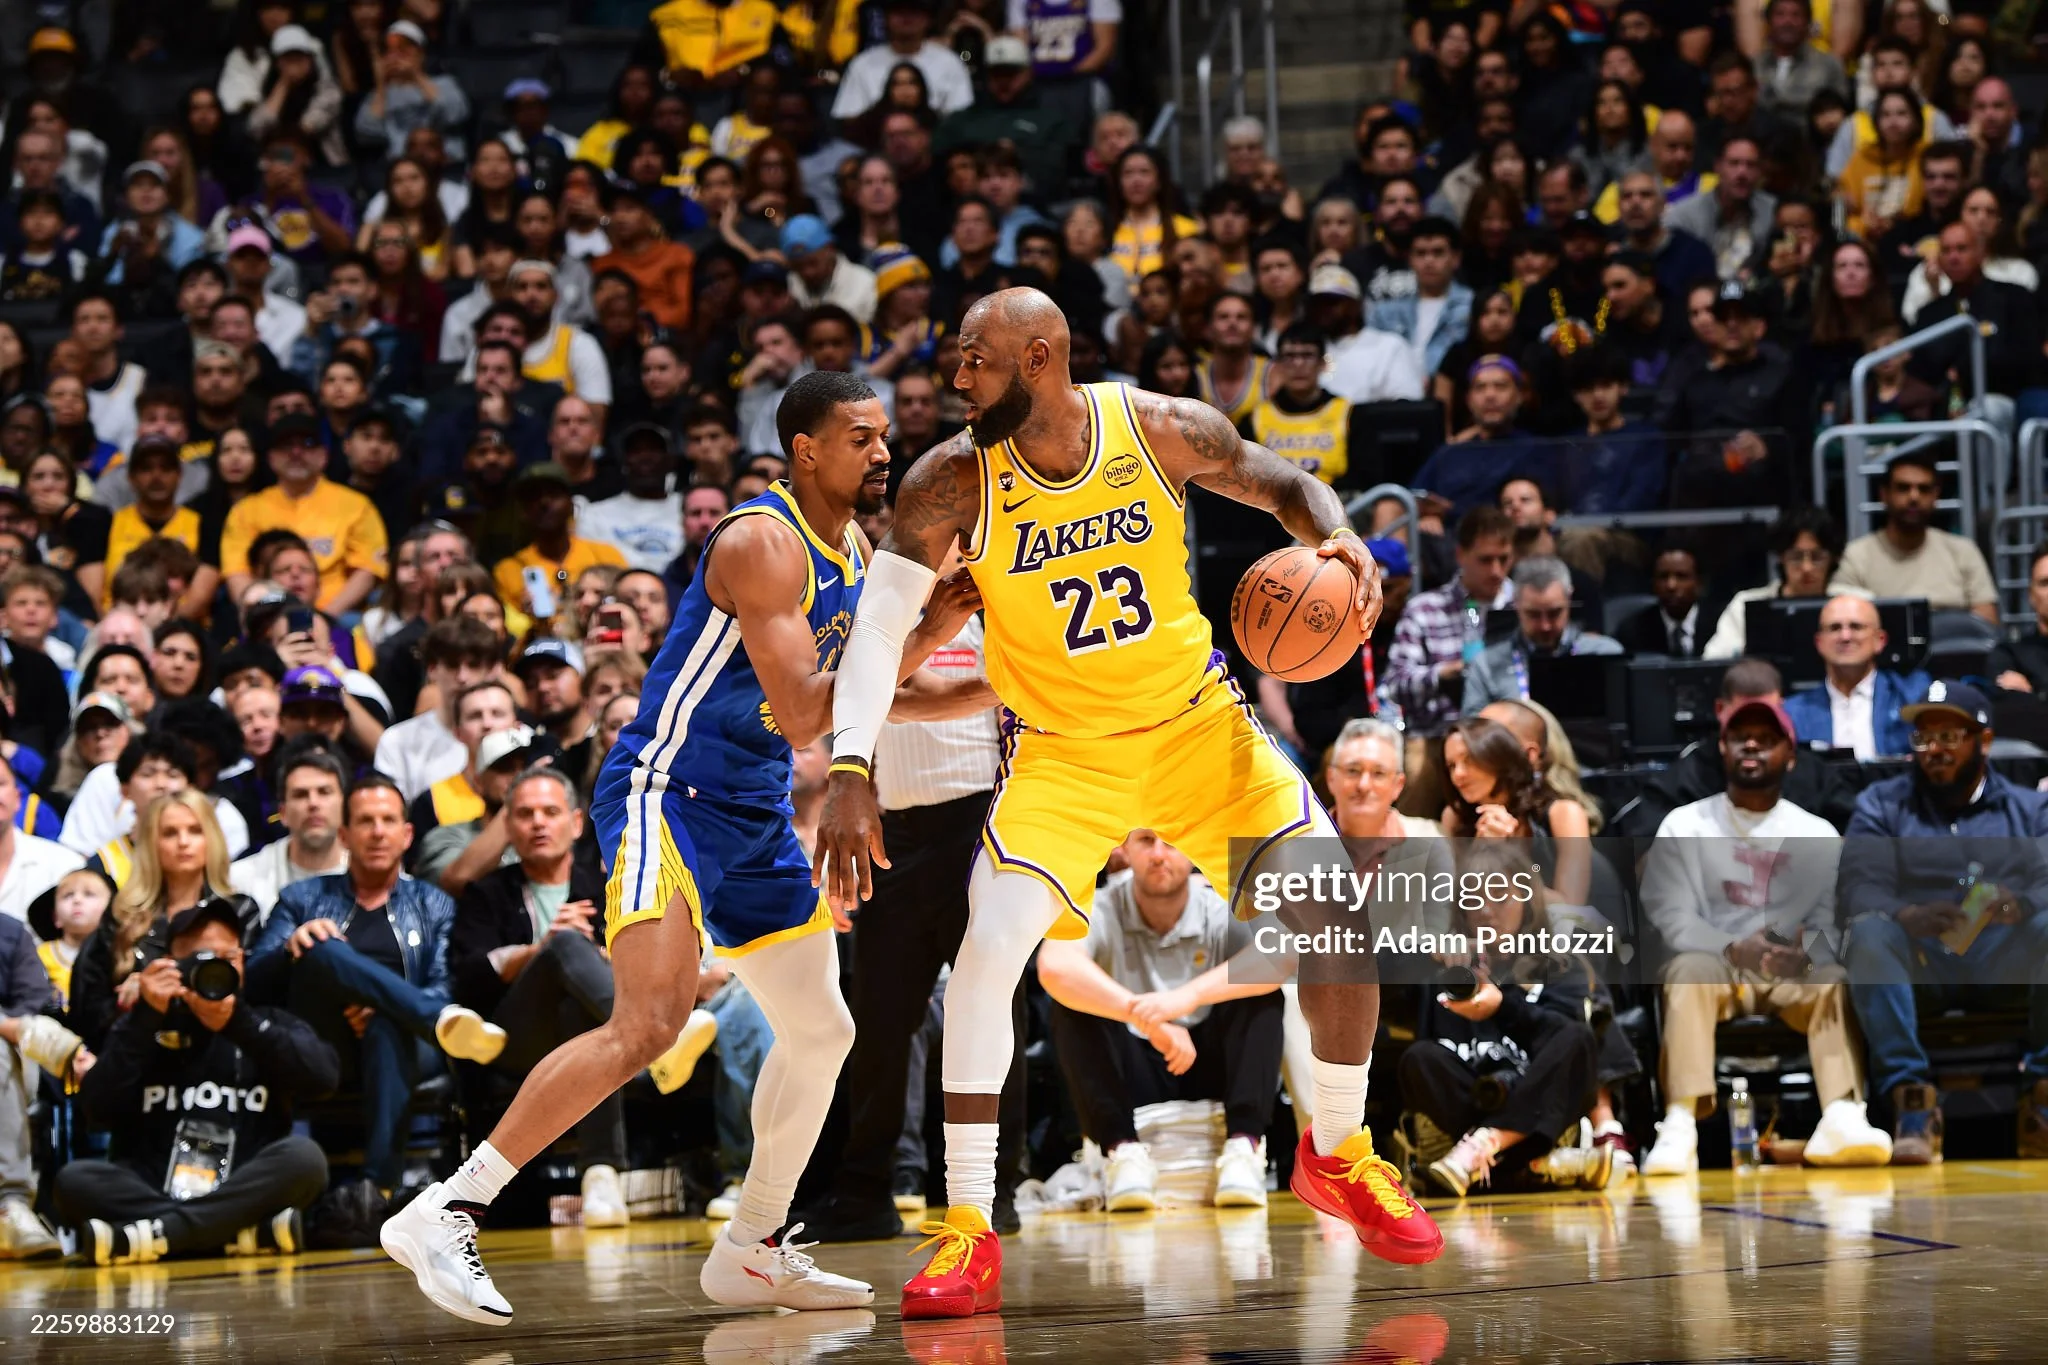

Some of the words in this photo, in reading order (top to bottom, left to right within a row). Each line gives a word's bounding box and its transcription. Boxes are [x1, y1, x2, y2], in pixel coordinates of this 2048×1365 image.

[1105, 461, 1139, 479] bibigo
[1007, 501, 1153, 574] LAKERS
[1047, 564, 1156, 657] 23
